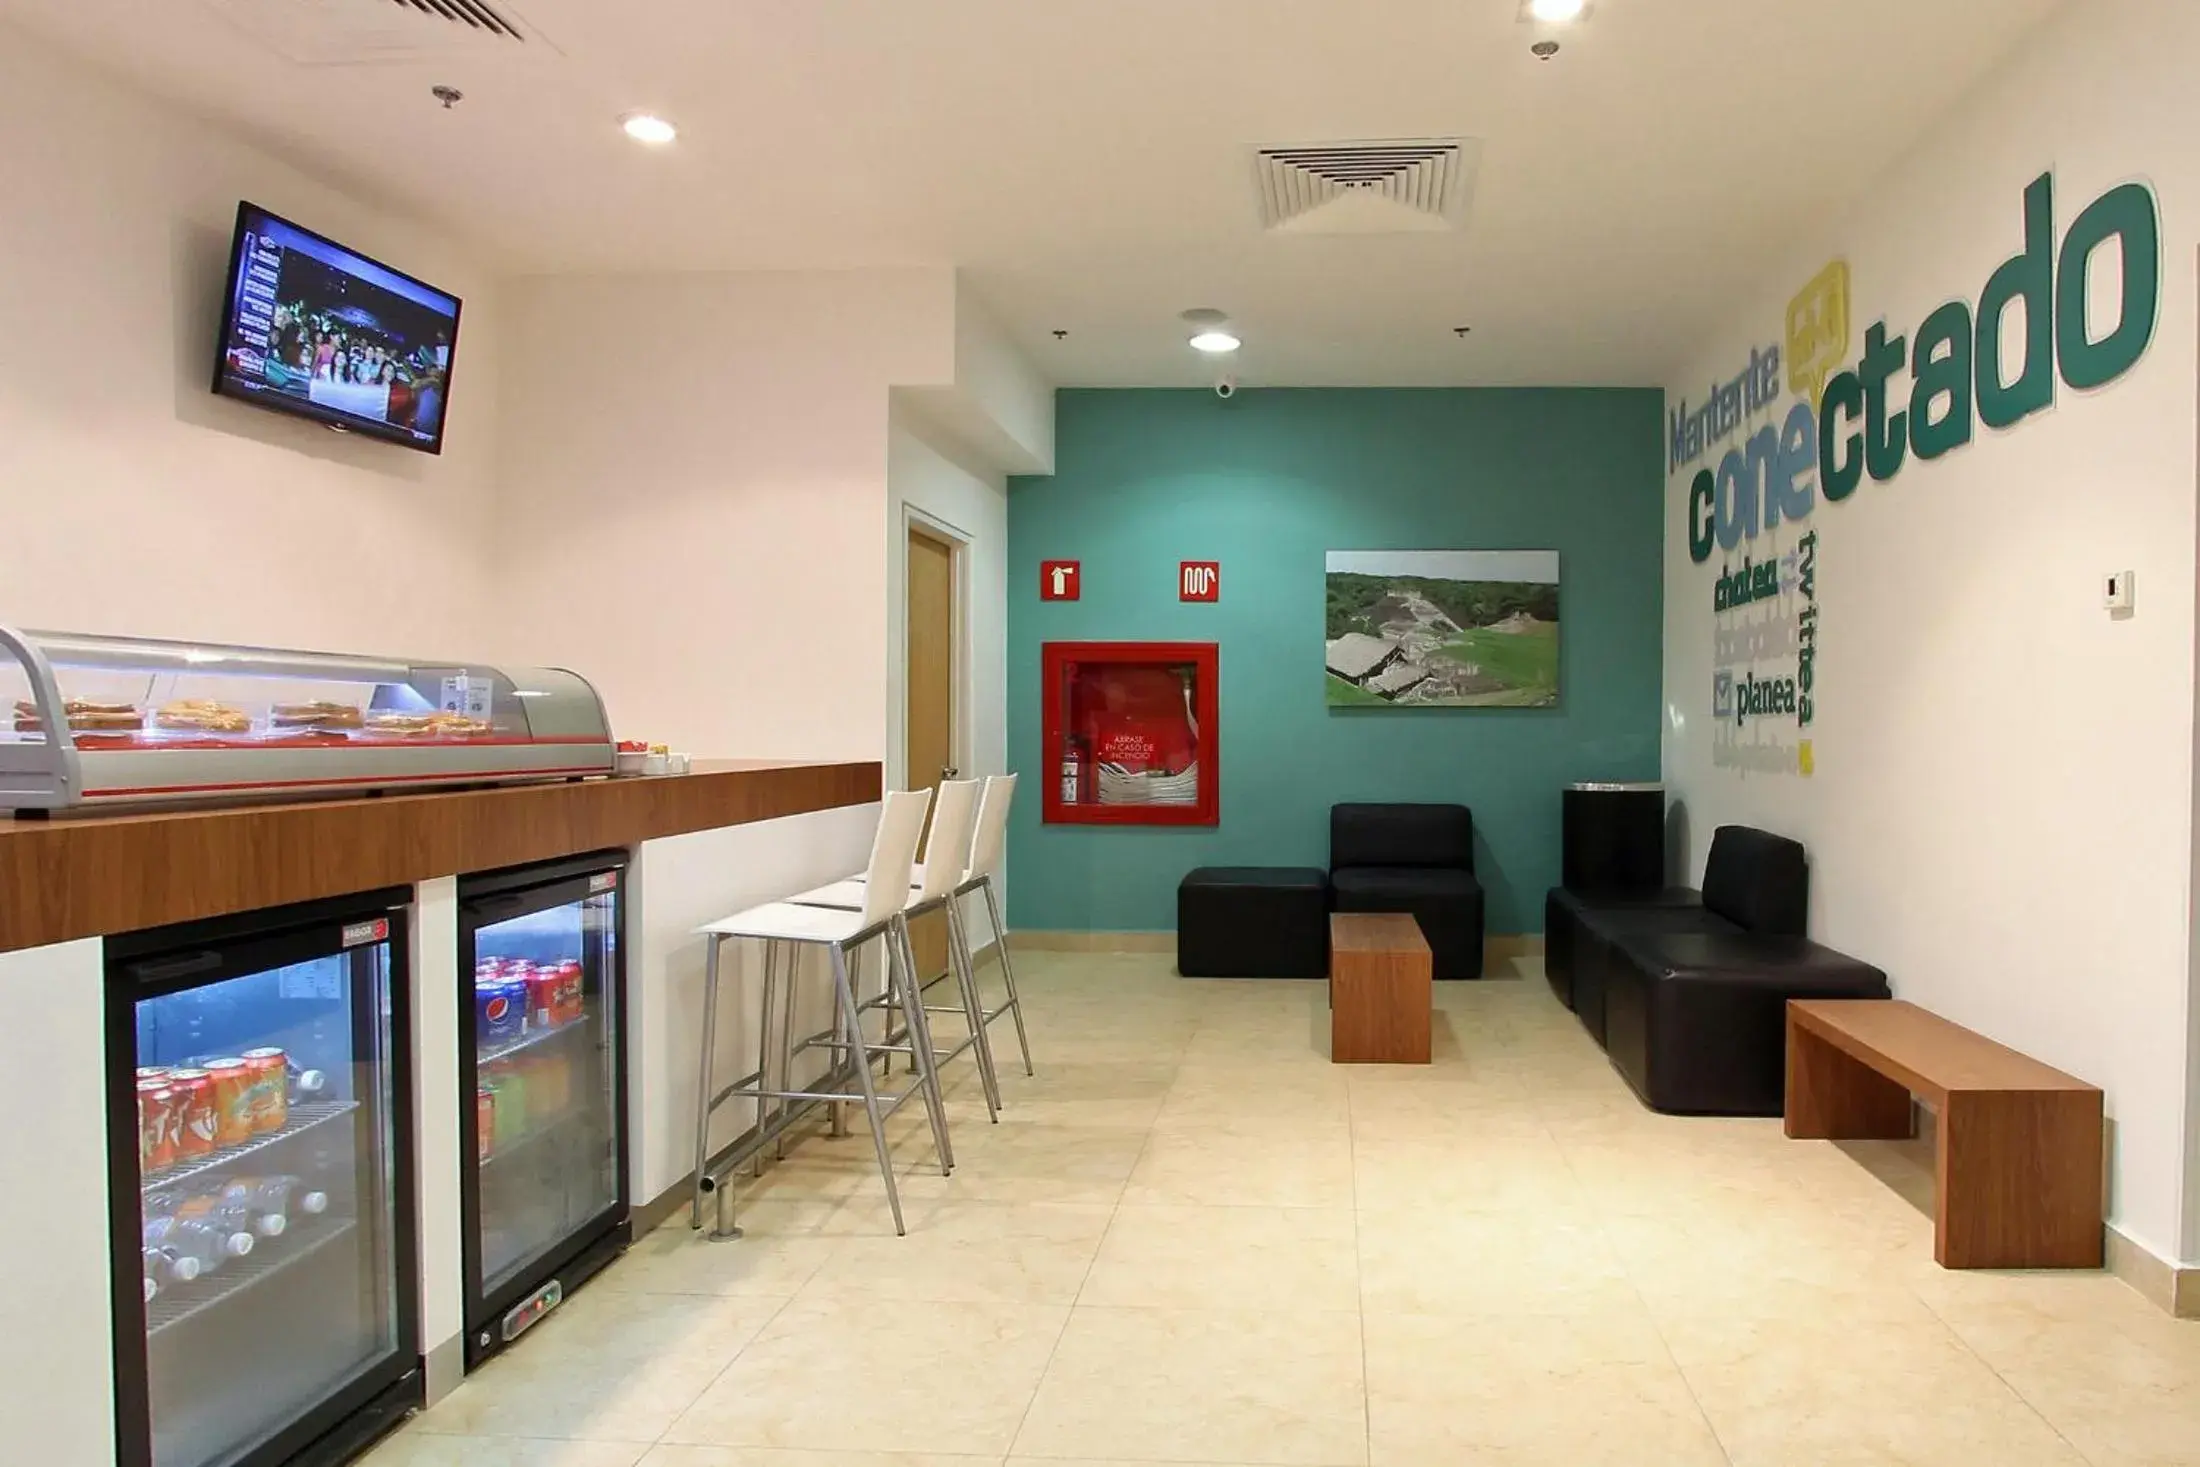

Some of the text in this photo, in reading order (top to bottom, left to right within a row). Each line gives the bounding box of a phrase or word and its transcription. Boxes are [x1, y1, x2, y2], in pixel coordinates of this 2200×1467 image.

[1669, 345, 1779, 475] Mantente
[1689, 171, 2159, 564] conectado
[1714, 556, 1778, 612] chatea
[1799, 530, 1816, 727] twittea
[1737, 672, 1796, 727] planea
